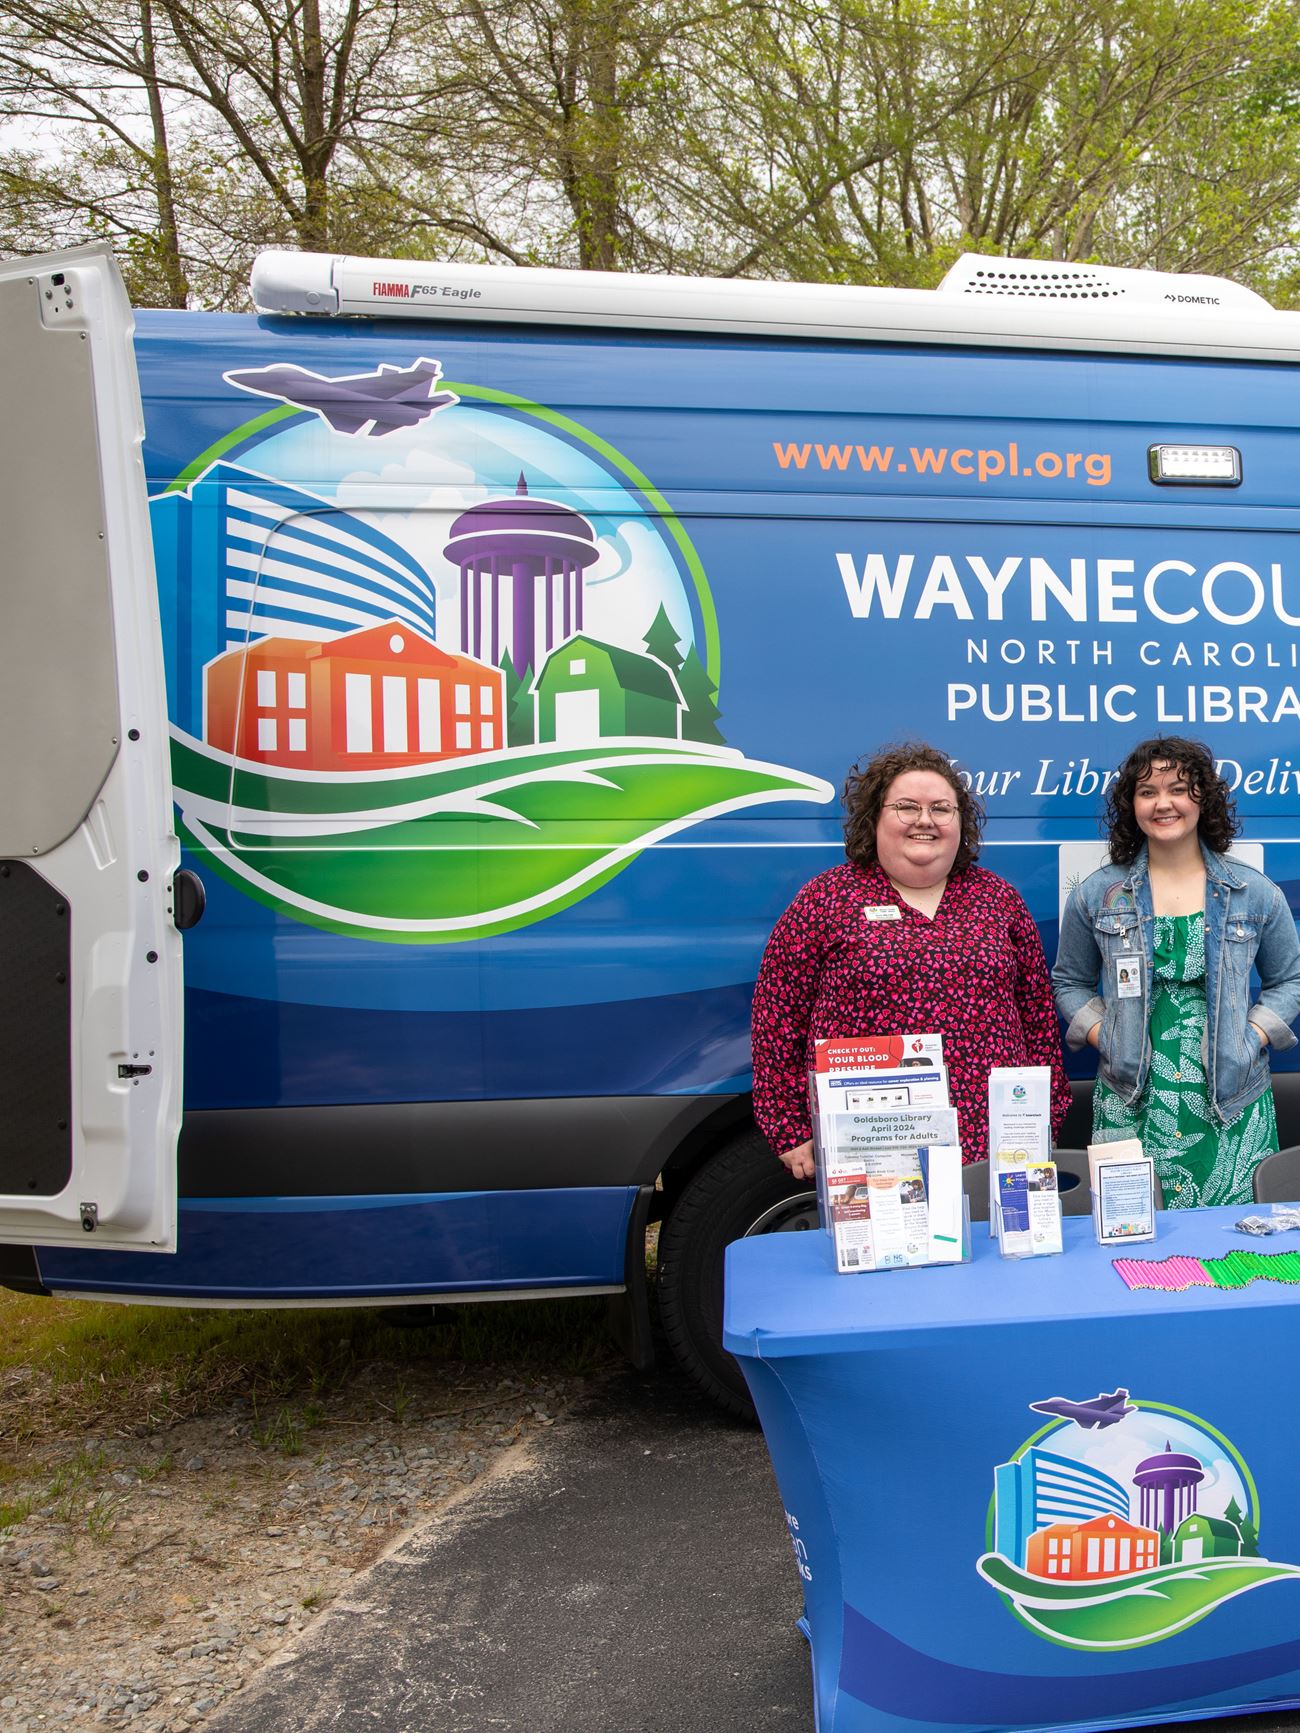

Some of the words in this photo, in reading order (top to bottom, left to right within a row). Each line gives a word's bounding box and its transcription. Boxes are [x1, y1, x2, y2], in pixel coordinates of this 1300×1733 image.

[373, 282, 409, 298] FIAMMA
[441, 286, 482, 300] Eagle
[1177, 295, 1221, 305] DOMETIC
[772, 442, 1112, 486] www.wcpl.org
[967, 639, 1112, 665] NORTH
[947, 683, 1137, 723] PUBLIC
[947, 759, 1021, 796] our
[1030, 758, 1120, 797] Libr
[828, 1055, 855, 1064] YOUR
[857, 1053, 889, 1063] BLOOD
[853, 1115, 899, 1124] Goldsboro
[900, 1114, 932, 1123] Library
[871, 1124, 892, 1134] April
[893, 1124, 916, 1132] 2024
[851, 1134, 893, 1144] Programs
[894, 1133, 908, 1141] for
[909, 1132, 939, 1141] Adults
